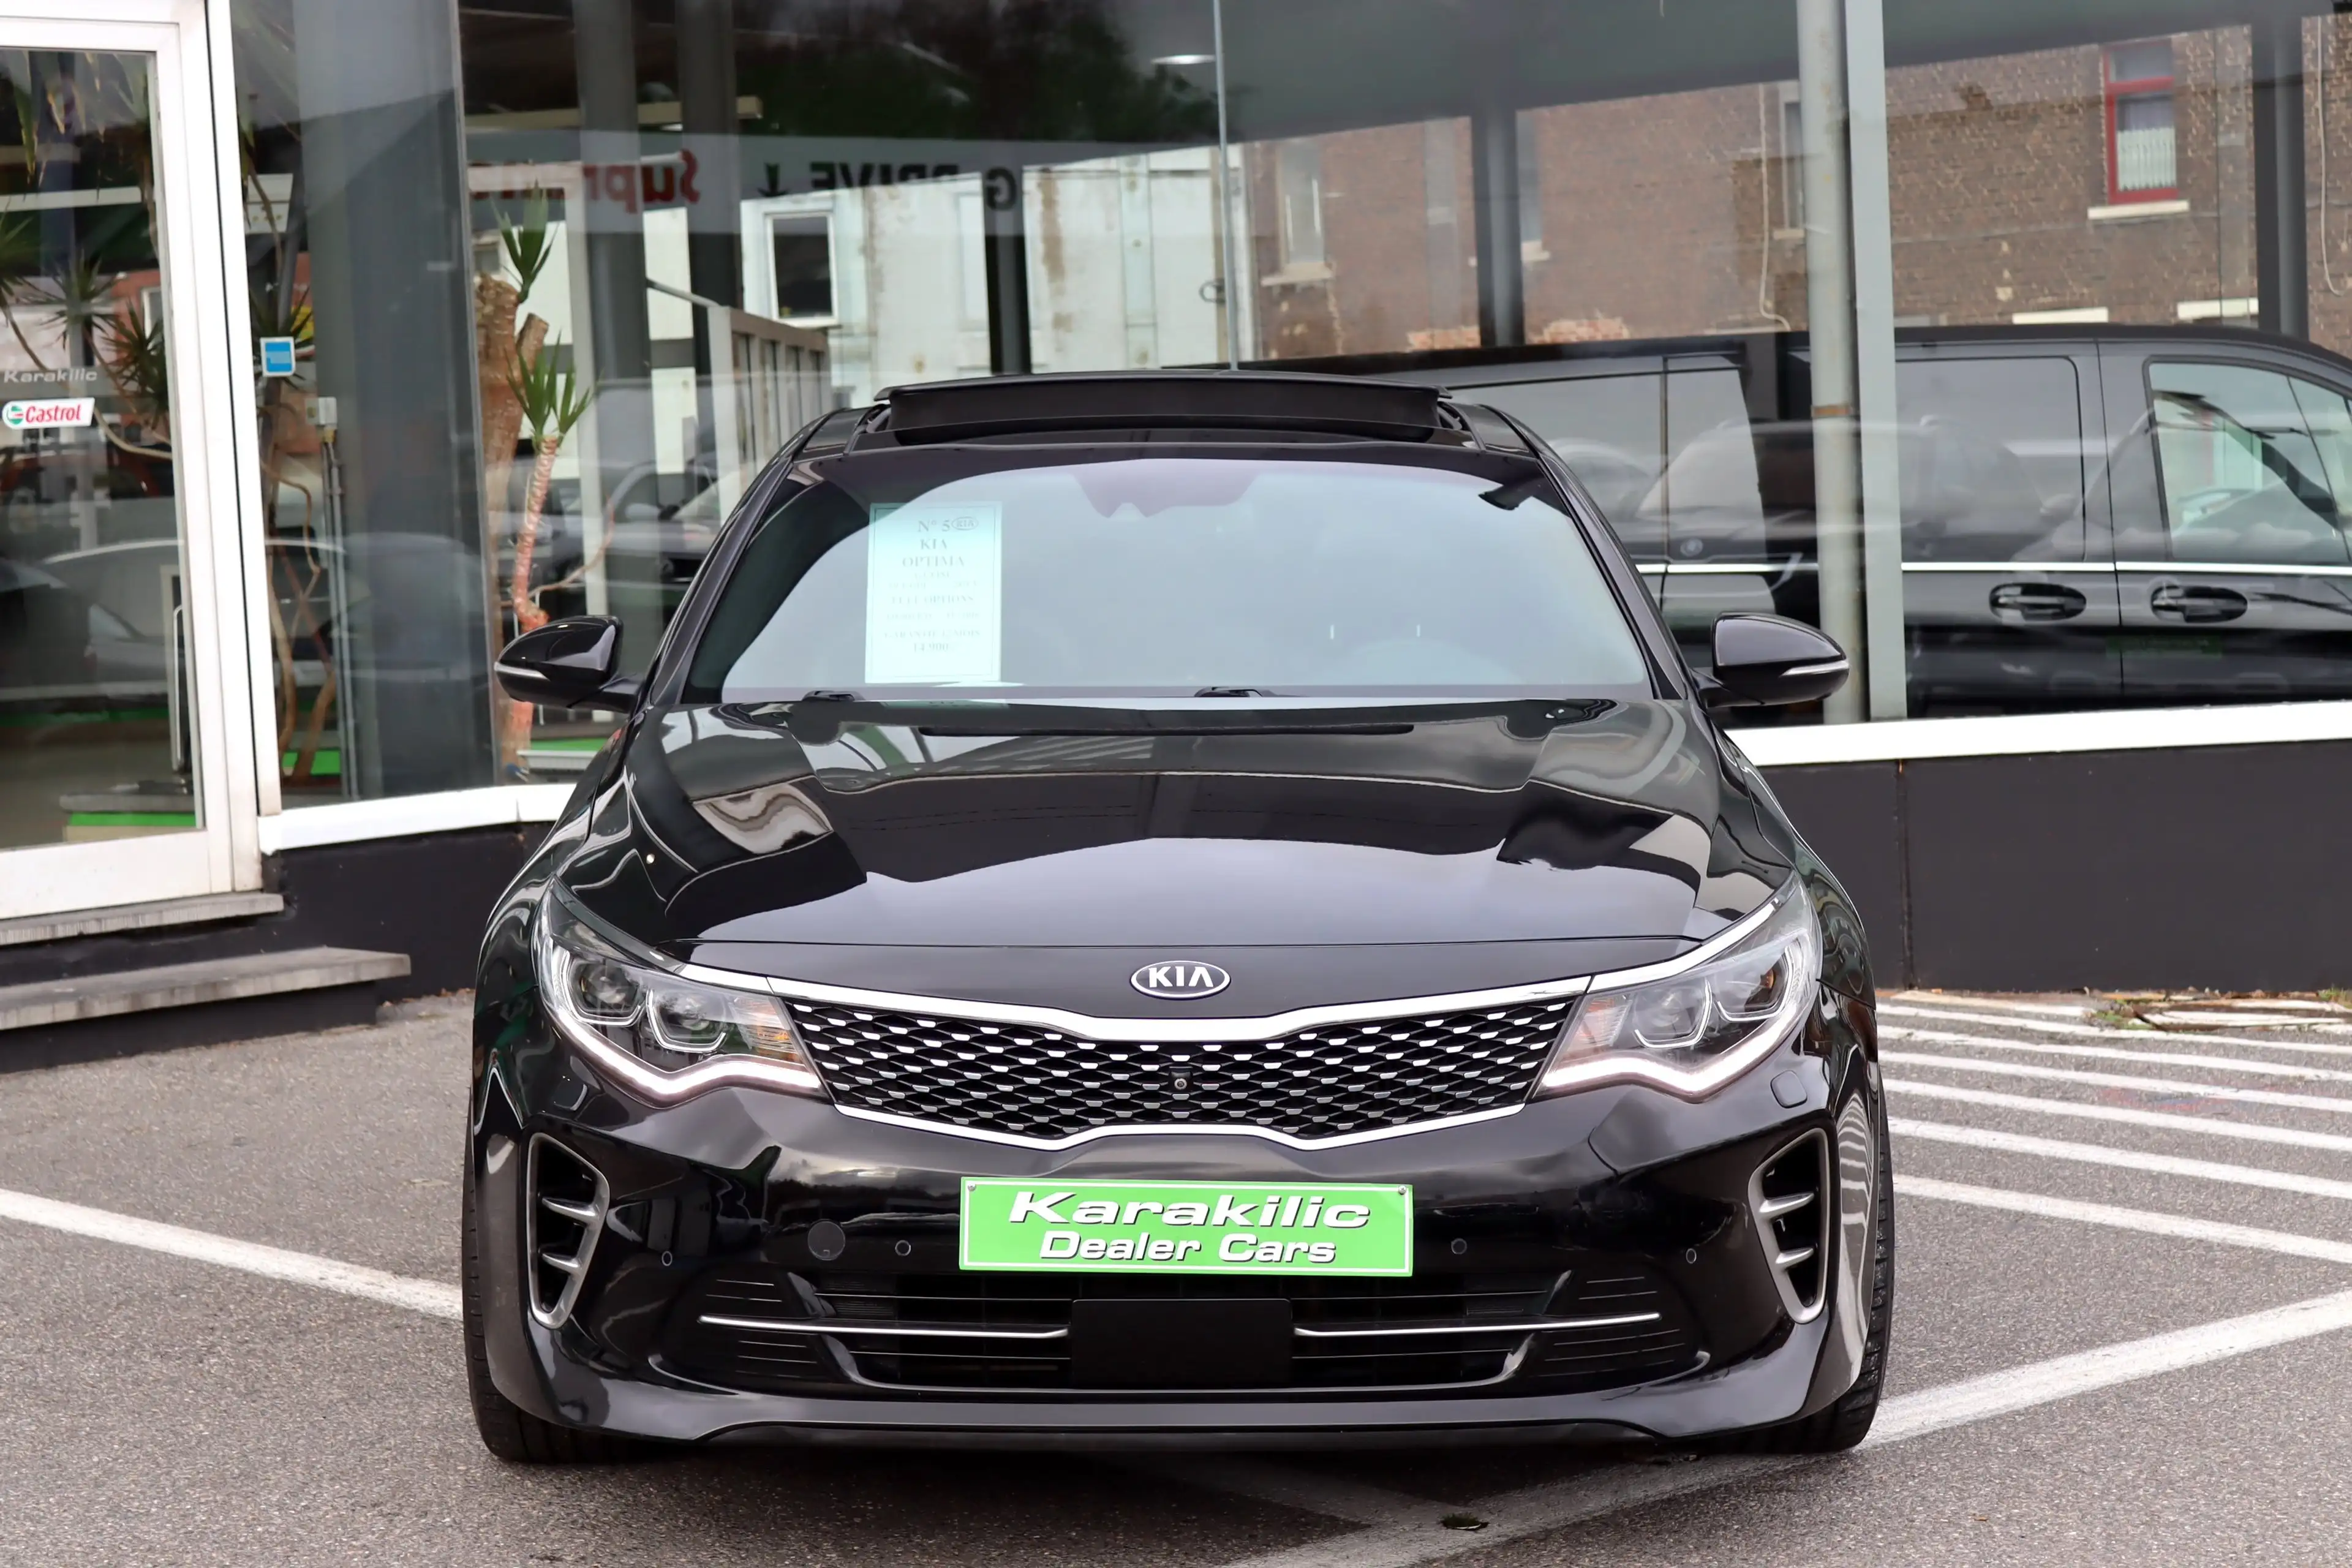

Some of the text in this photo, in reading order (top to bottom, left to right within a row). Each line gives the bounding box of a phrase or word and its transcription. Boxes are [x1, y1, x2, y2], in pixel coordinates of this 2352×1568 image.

[25, 404, 81, 424] Castrol
[919, 538, 948, 550] KIA
[902, 555, 965, 567] OPTIMA
[1148, 966, 1214, 987] KIA
[1008, 1191, 1371, 1229] Karakilic
[1039, 1230, 1337, 1264] Dealer Cars
